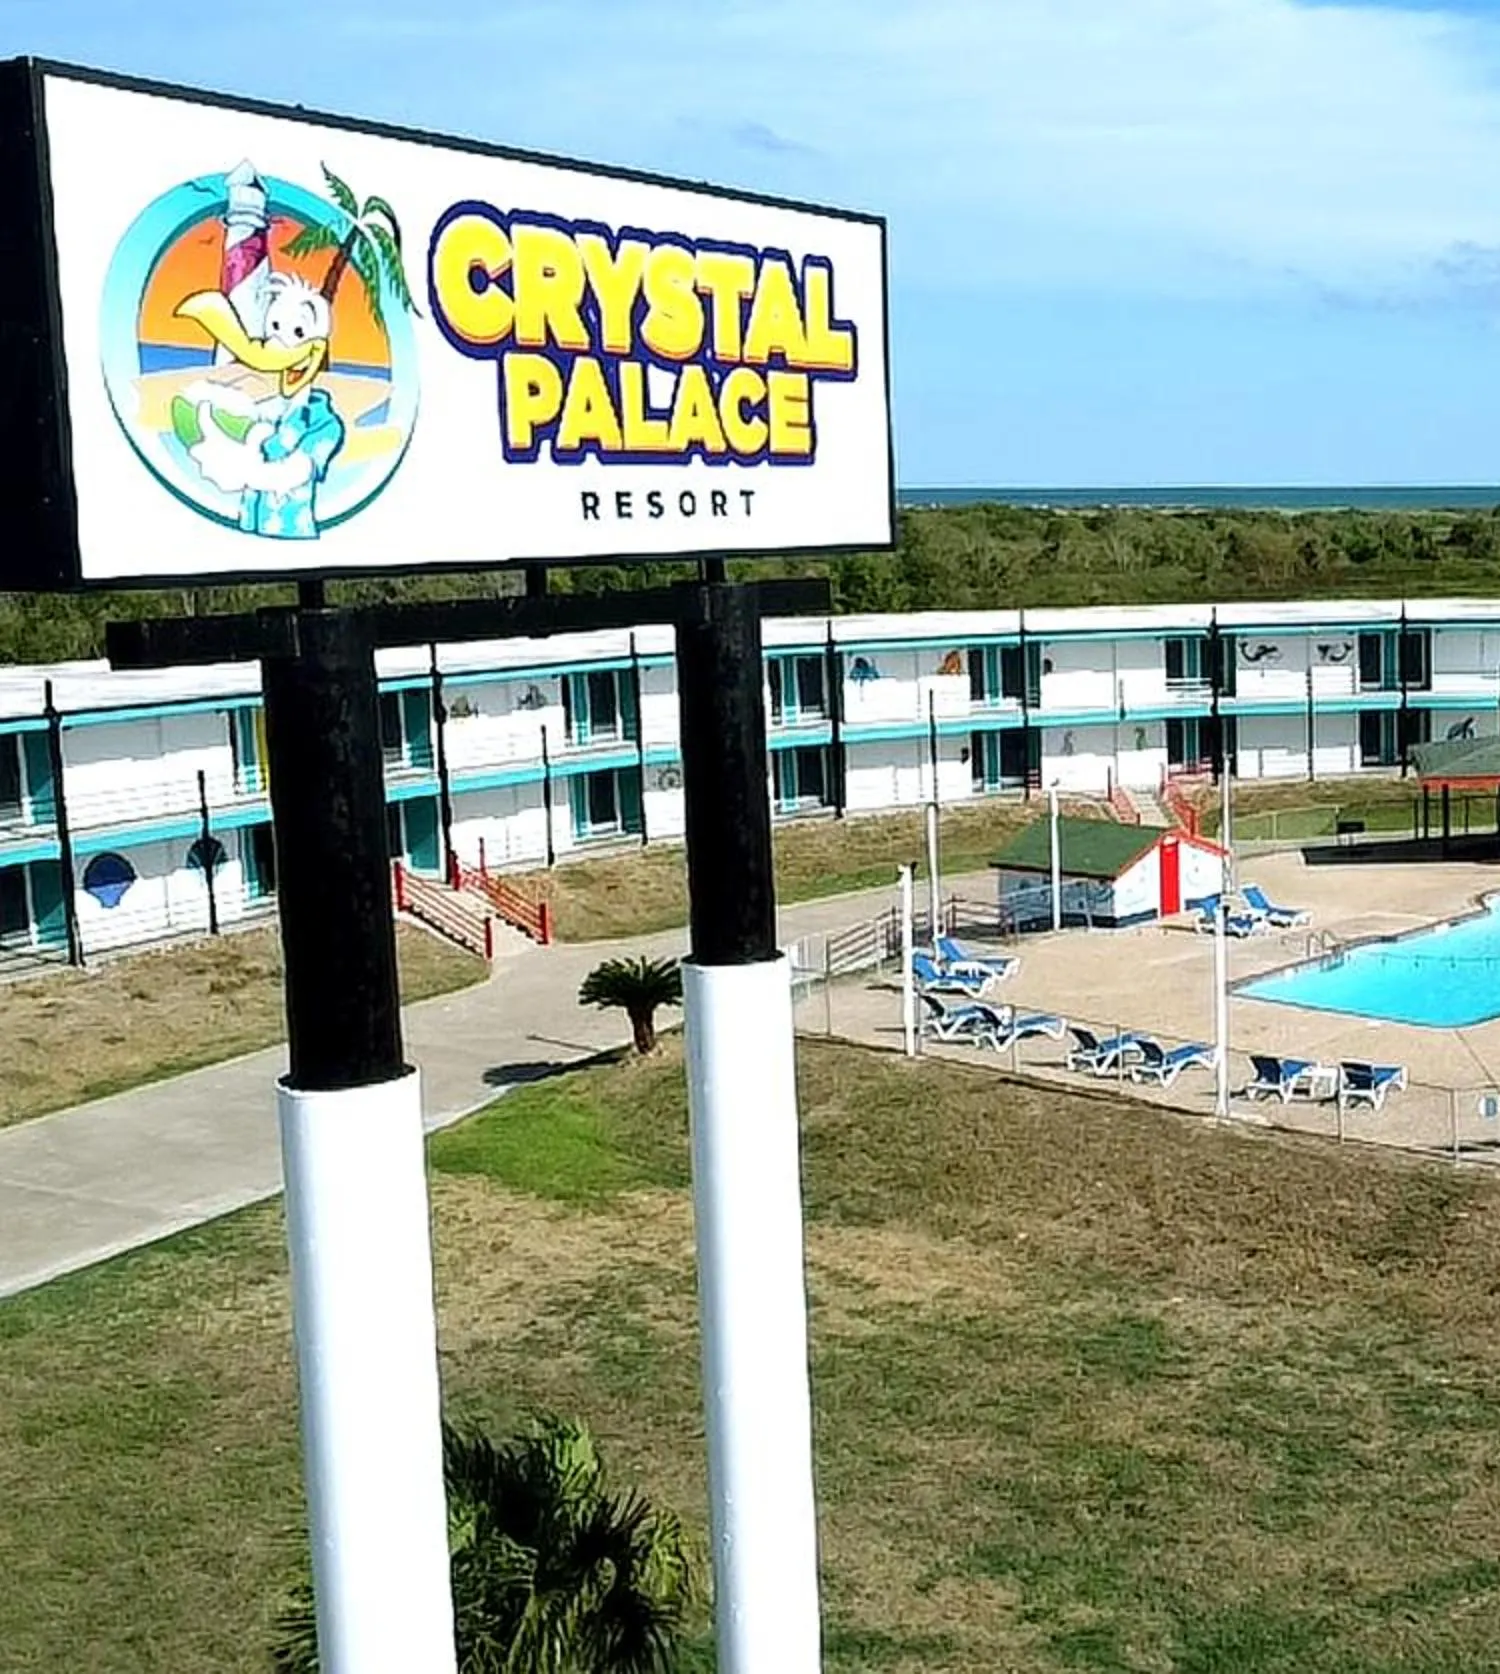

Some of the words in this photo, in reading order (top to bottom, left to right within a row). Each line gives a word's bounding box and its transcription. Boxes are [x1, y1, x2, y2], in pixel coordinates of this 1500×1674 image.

[431, 211, 855, 370] CRYSTAL
[503, 352, 813, 458] PALACE
[581, 490, 756, 520] RESORT
